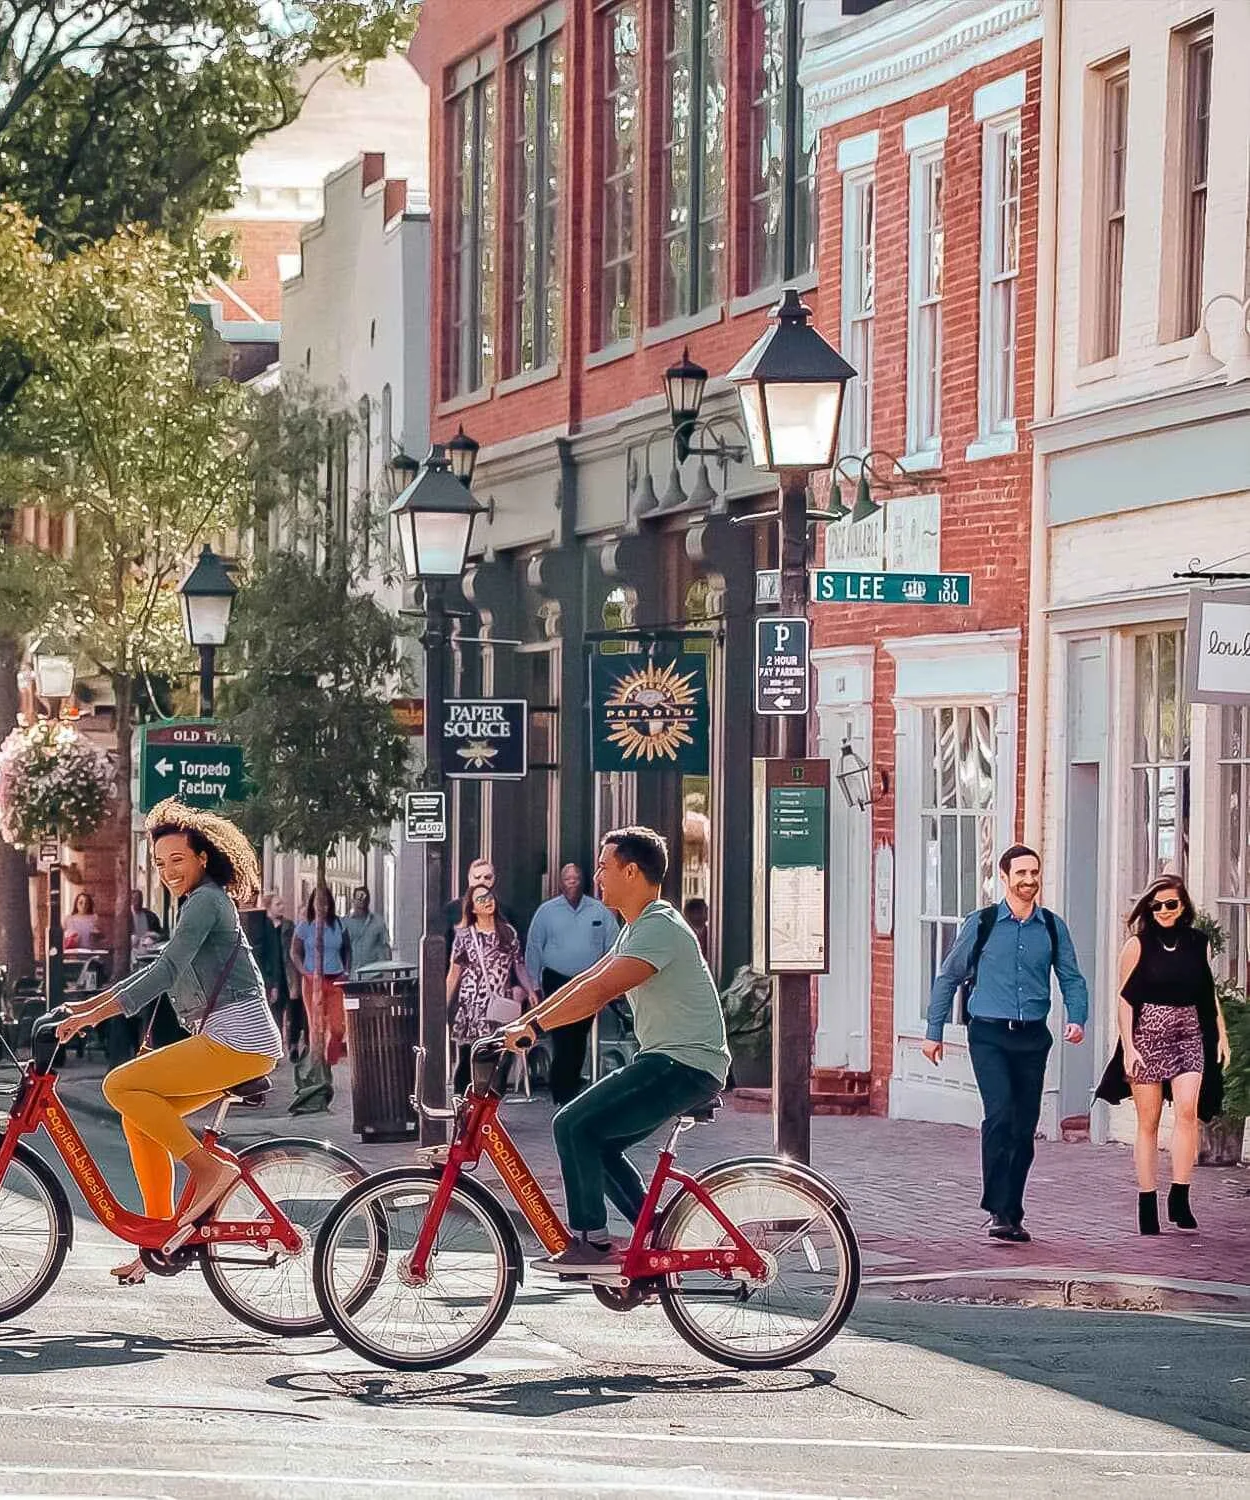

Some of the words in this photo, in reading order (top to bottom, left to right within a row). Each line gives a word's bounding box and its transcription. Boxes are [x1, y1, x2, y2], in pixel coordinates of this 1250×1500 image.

[821, 575, 834, 598] S
[846, 576, 885, 599] LEE
[942, 578, 958, 590] ST
[938, 590, 959, 602] 100
[774, 624, 790, 651] P
[766, 656, 774, 666] 2
[774, 656, 798, 666] HOUR
[759, 667, 774, 677] PAY
[775, 667, 805, 677] PARKING
[450, 705, 505, 721] PAPER
[606, 707, 695, 718] PARADISO
[173, 731, 200, 741] OLD
[443, 721, 511, 737] SOURCE
[179, 761, 230, 778] Torpedo
[179, 780, 227, 798] Factory
[46, 1107, 81, 1158] capital
[75, 1155, 116, 1221] bikeshare
[489, 1132, 527, 1184] capital
[520, 1181, 567, 1252] bikeshare
